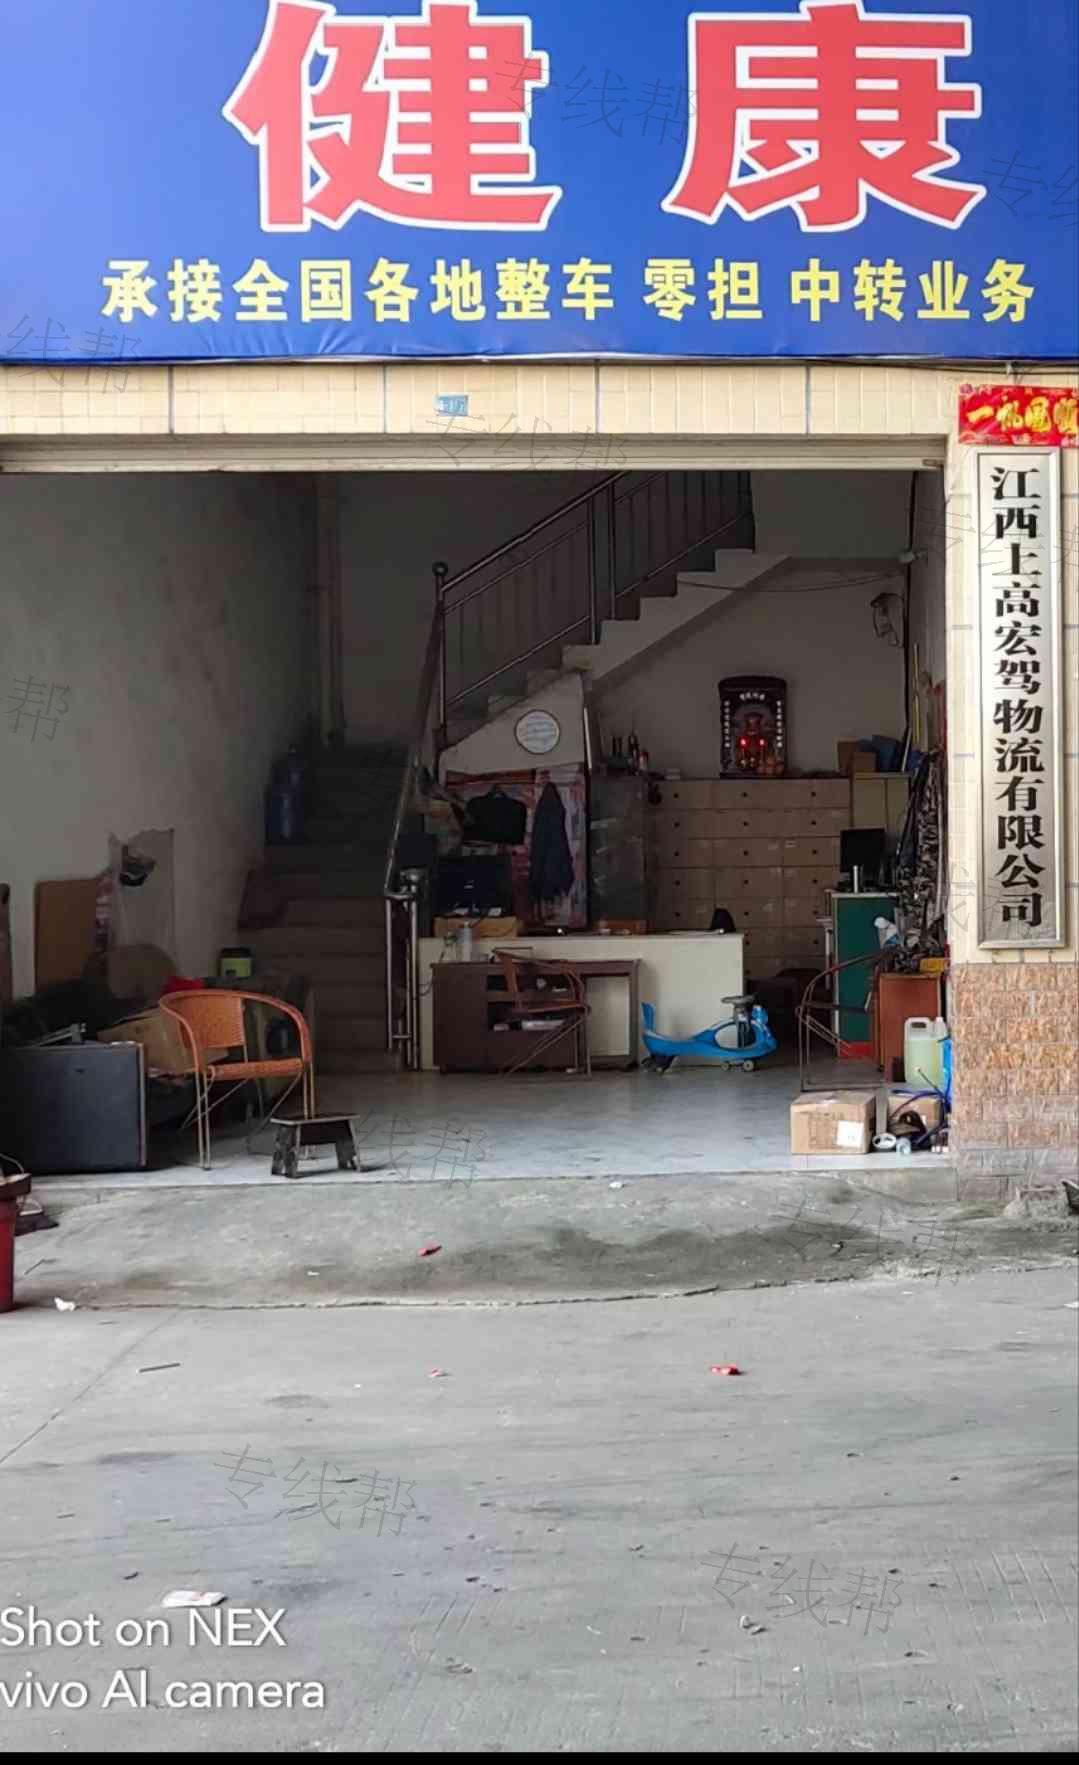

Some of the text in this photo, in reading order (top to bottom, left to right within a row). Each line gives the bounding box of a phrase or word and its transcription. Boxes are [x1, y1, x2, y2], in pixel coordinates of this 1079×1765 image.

[223, 0, 986, 233] 健康
[101, 257, 1035, 323] 承接全国各地整车 零担 中转业务
[990, 466, 1047, 927] 江西上高宏驾物流有限公司
